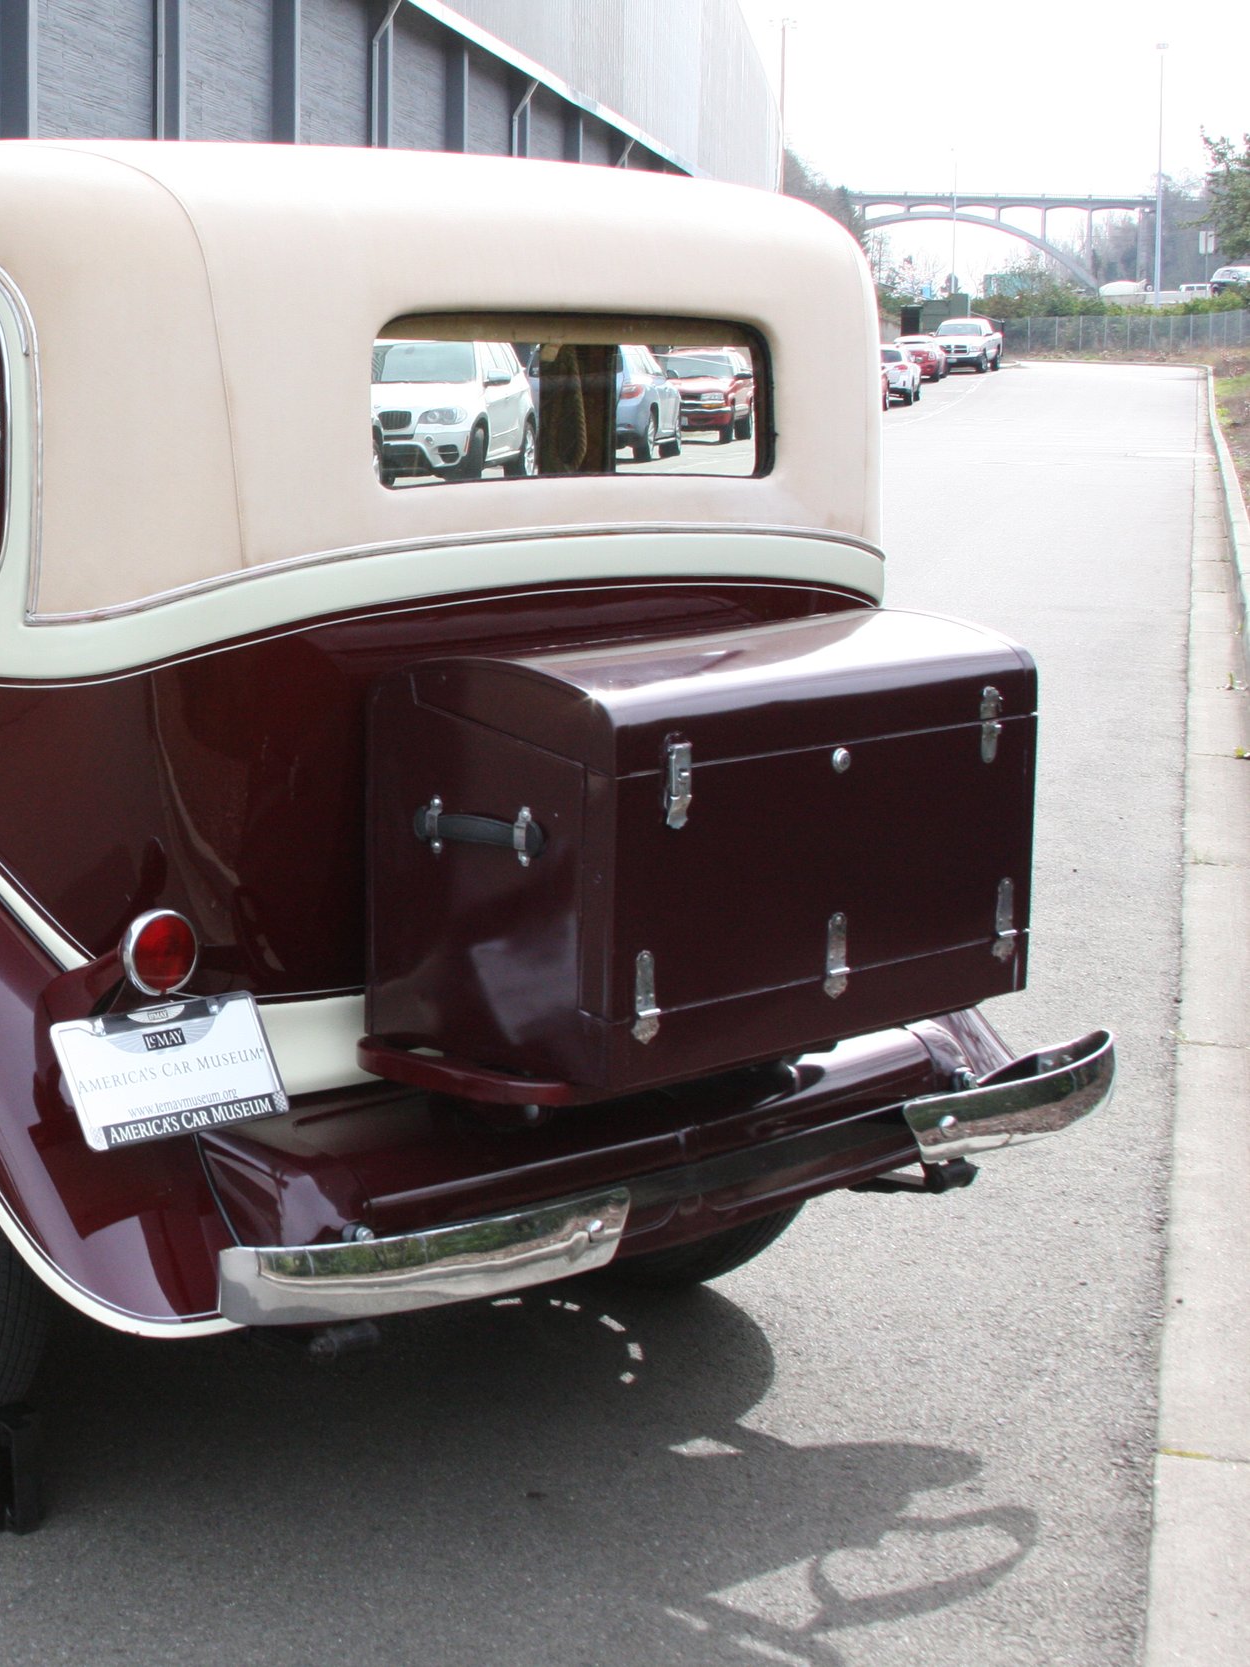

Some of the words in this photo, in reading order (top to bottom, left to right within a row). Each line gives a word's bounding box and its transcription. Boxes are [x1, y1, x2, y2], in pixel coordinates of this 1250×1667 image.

[161, 1060, 193, 1078] CAR
[110, 1115, 180, 1144] AMERICA'S
[181, 1110, 211, 1129] CAR
[210, 1097, 273, 1123] MUSEUM
